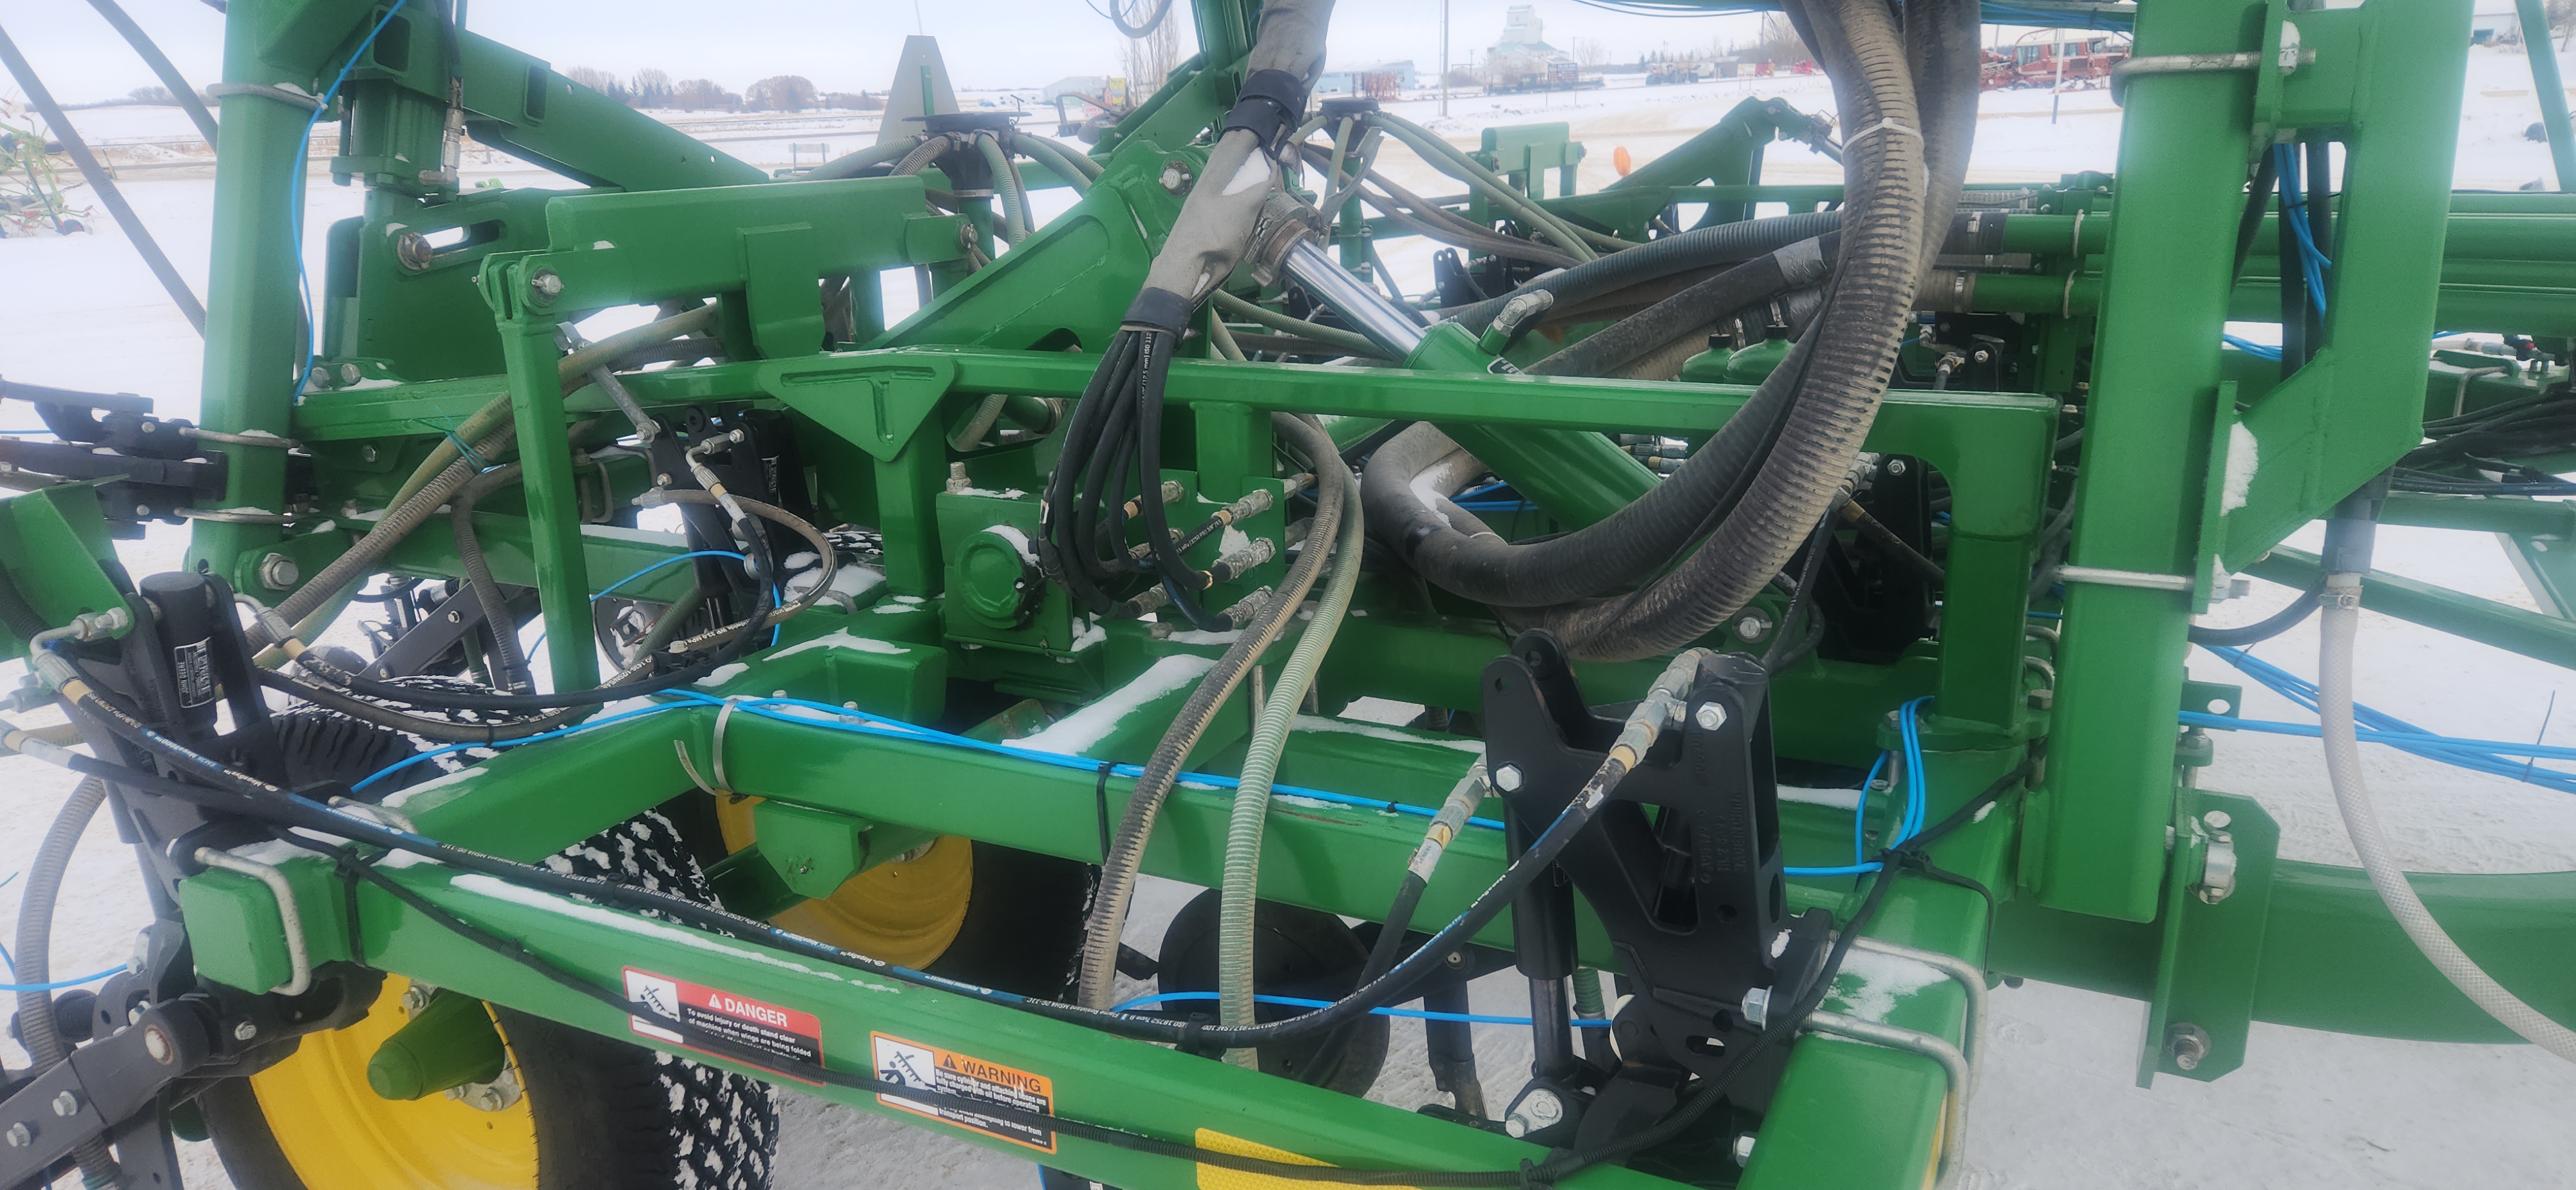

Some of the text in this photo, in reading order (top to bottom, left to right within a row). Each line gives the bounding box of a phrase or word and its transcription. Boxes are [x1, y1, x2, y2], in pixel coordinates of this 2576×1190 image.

[178, 661, 189, 694] JOHN DEERE
[725, 997, 788, 1028] DANGER
[1069, 1002, 1099, 1016] Resistant
[687, 1008, 696, 1017] To
[697, 1010, 714, 1021] avoid
[734, 1021, 741, 1029] or
[741, 1022, 759, 1034] death
[760, 1026, 779, 1039] stand
[780, 1033, 795, 1044] clear
[696, 1020, 722, 1032] machine
[723, 1026, 739, 1037] when
[741, 1031, 759, 1044] wings
[772, 1041, 790, 1052] being
[790, 1045, 811, 1057] folded
[936, 1068, 944, 1077] Be
[944, 1072, 956, 1081] sure
[980, 1079, 991, 1090] and
[1036, 1097, 1046, 1106] are
[963, 1060, 1041, 1092] WARNING
[936, 1077, 949, 1088] fully
[949, 1080, 971, 1093] charged
[994, 1091, 1012, 1102] before
[1012, 1098, 1039, 1111] operating
[939, 1108, 963, 1122] transport
[964, 1116, 989, 1128] position.
[1011, 1121, 1027, 1132] lower
[1028, 1125, 1042, 1136] from
